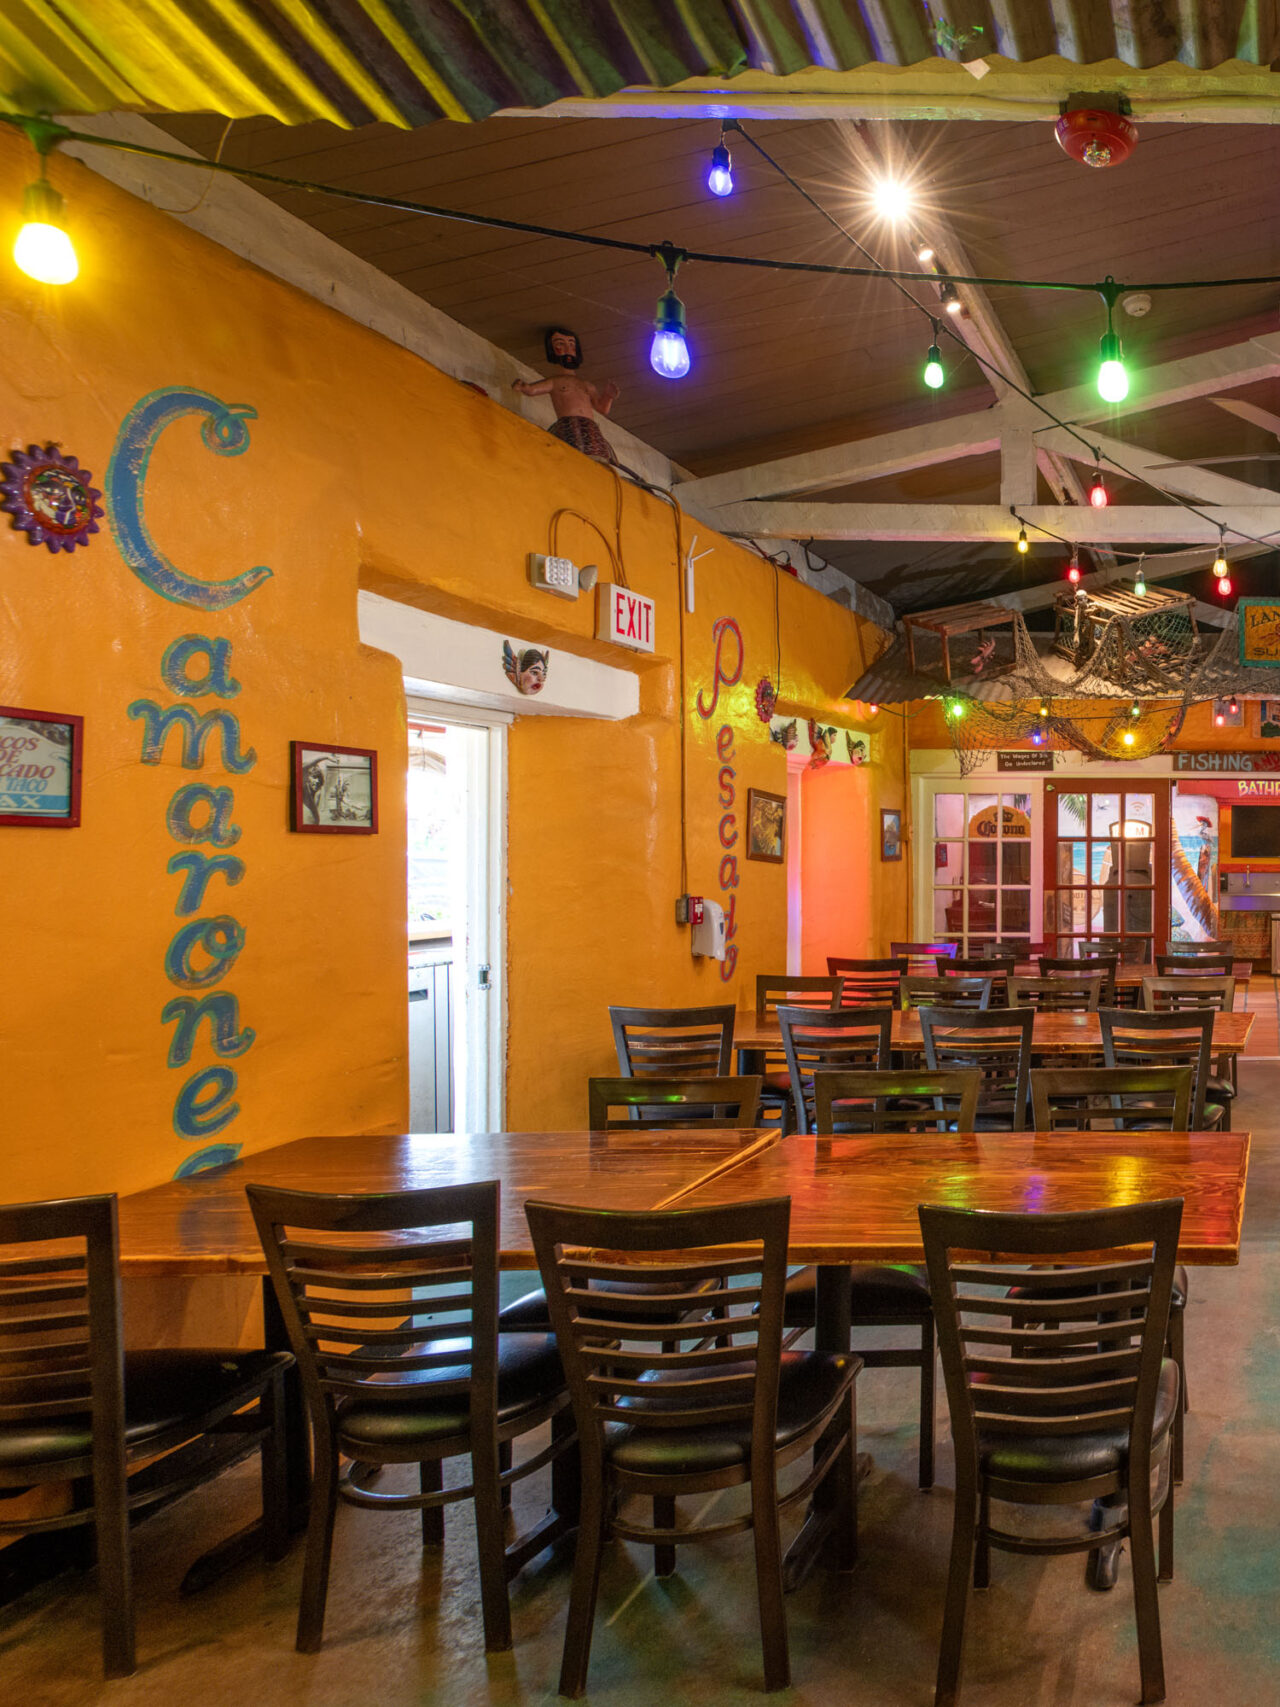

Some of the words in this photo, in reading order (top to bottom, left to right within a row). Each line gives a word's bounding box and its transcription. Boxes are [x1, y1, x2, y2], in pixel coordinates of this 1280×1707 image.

[615, 592, 653, 644] EXIT
[0, 735, 40, 751] COS
[1178, 754, 1252, 771] FISHING
[697, 616, 744, 983] Pescado
[977, 821, 1027, 837] Coona
